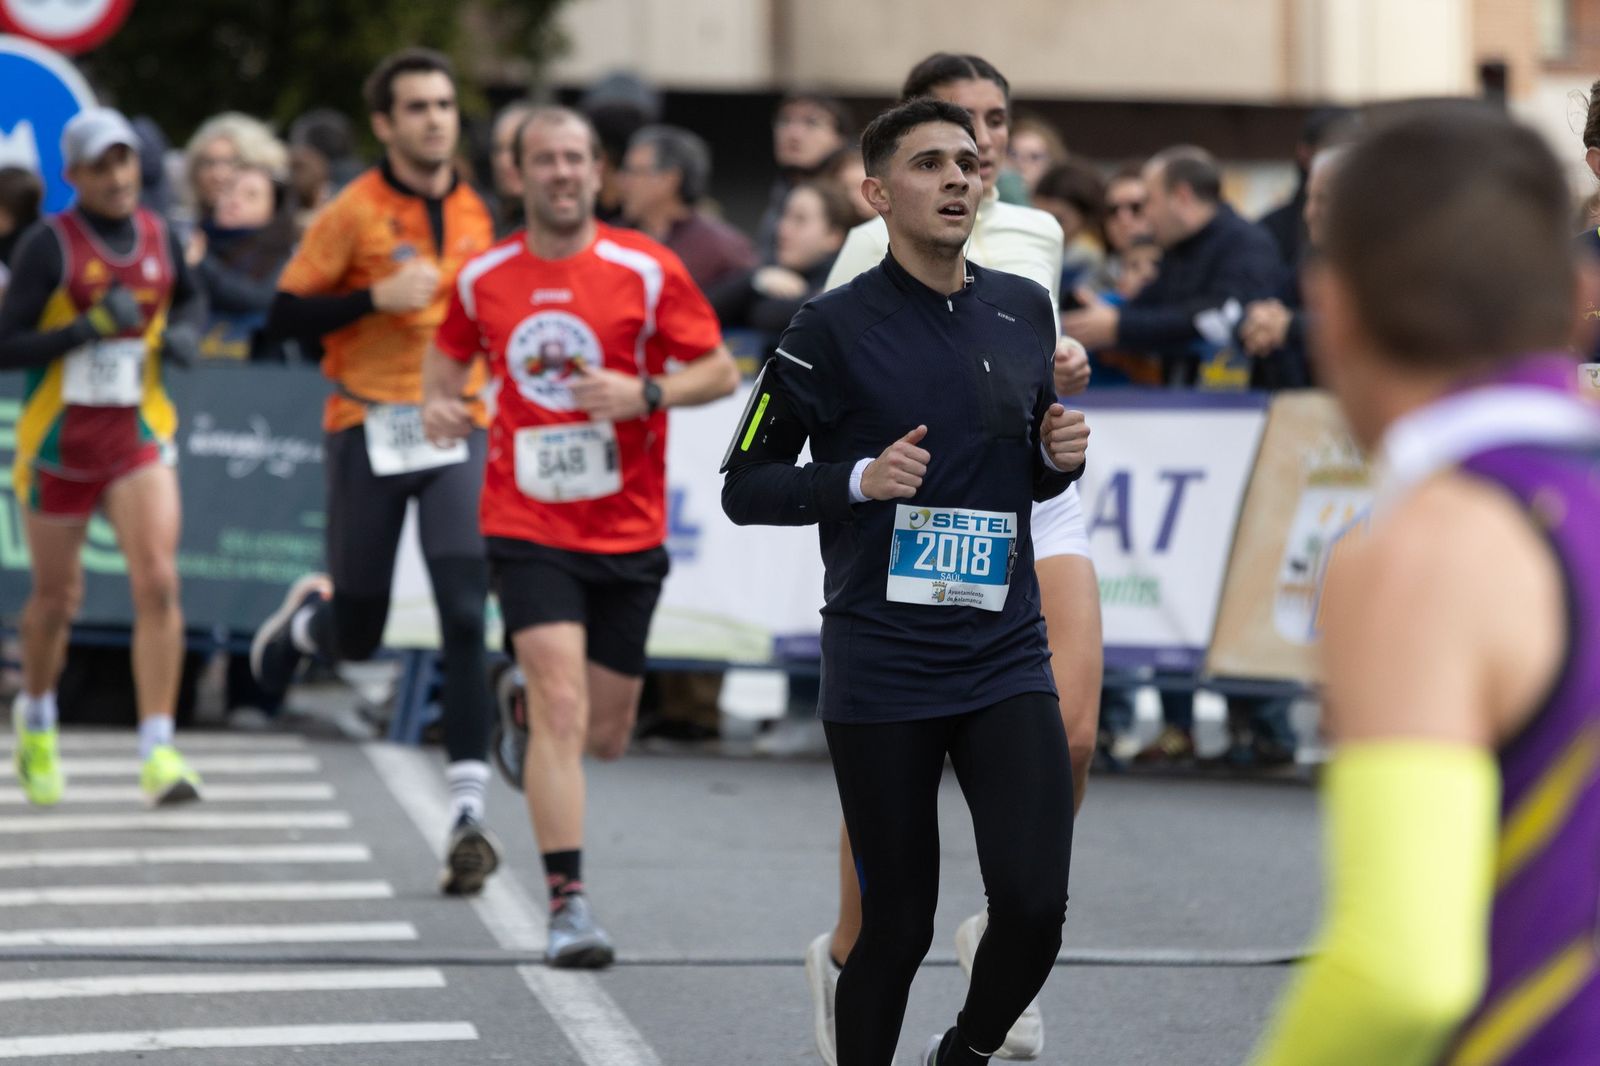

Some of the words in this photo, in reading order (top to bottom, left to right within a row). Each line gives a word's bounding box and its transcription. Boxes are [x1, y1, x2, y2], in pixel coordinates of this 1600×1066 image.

[1078, 470, 1206, 552] AT
[932, 512, 1012, 534] SETEL
[913, 531, 993, 577] 2018
[940, 572, 963, 582] SAÚL
[947, 588, 984, 598] Ayuntamiento
